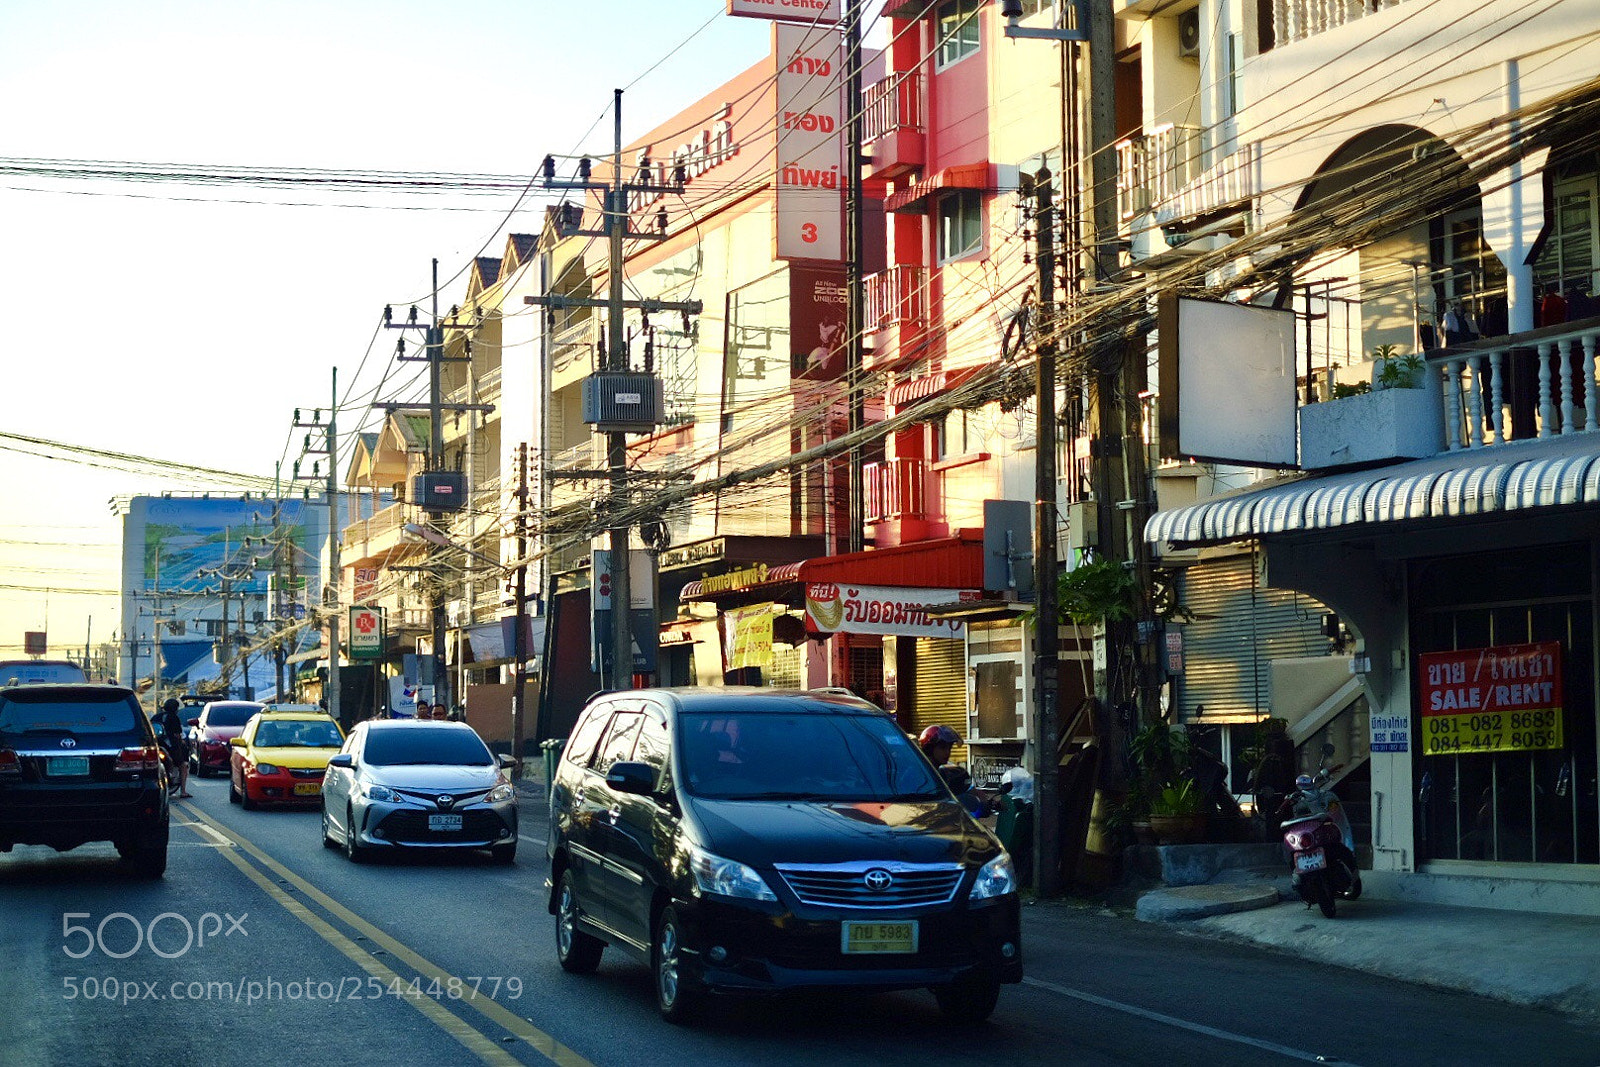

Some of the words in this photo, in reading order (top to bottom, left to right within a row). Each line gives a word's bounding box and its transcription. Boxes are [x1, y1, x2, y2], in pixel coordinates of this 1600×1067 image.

[787, 50, 831, 77] ห้าง
[784, 111, 835, 133] ทอง
[801, 223, 818, 243] 3
[1428, 661, 1466, 686] ขาย
[1487, 645, 1554, 680] ให้เช่า
[1430, 682, 1554, 712] SALE/RENT
[1429, 714, 1502, 735] 081-082
[1510, 710, 1556, 730] 8683
[1430, 733, 1503, 752] 084-447
[1511, 730, 1556, 749] 8059
[880, 926, 910, 939] 5983
